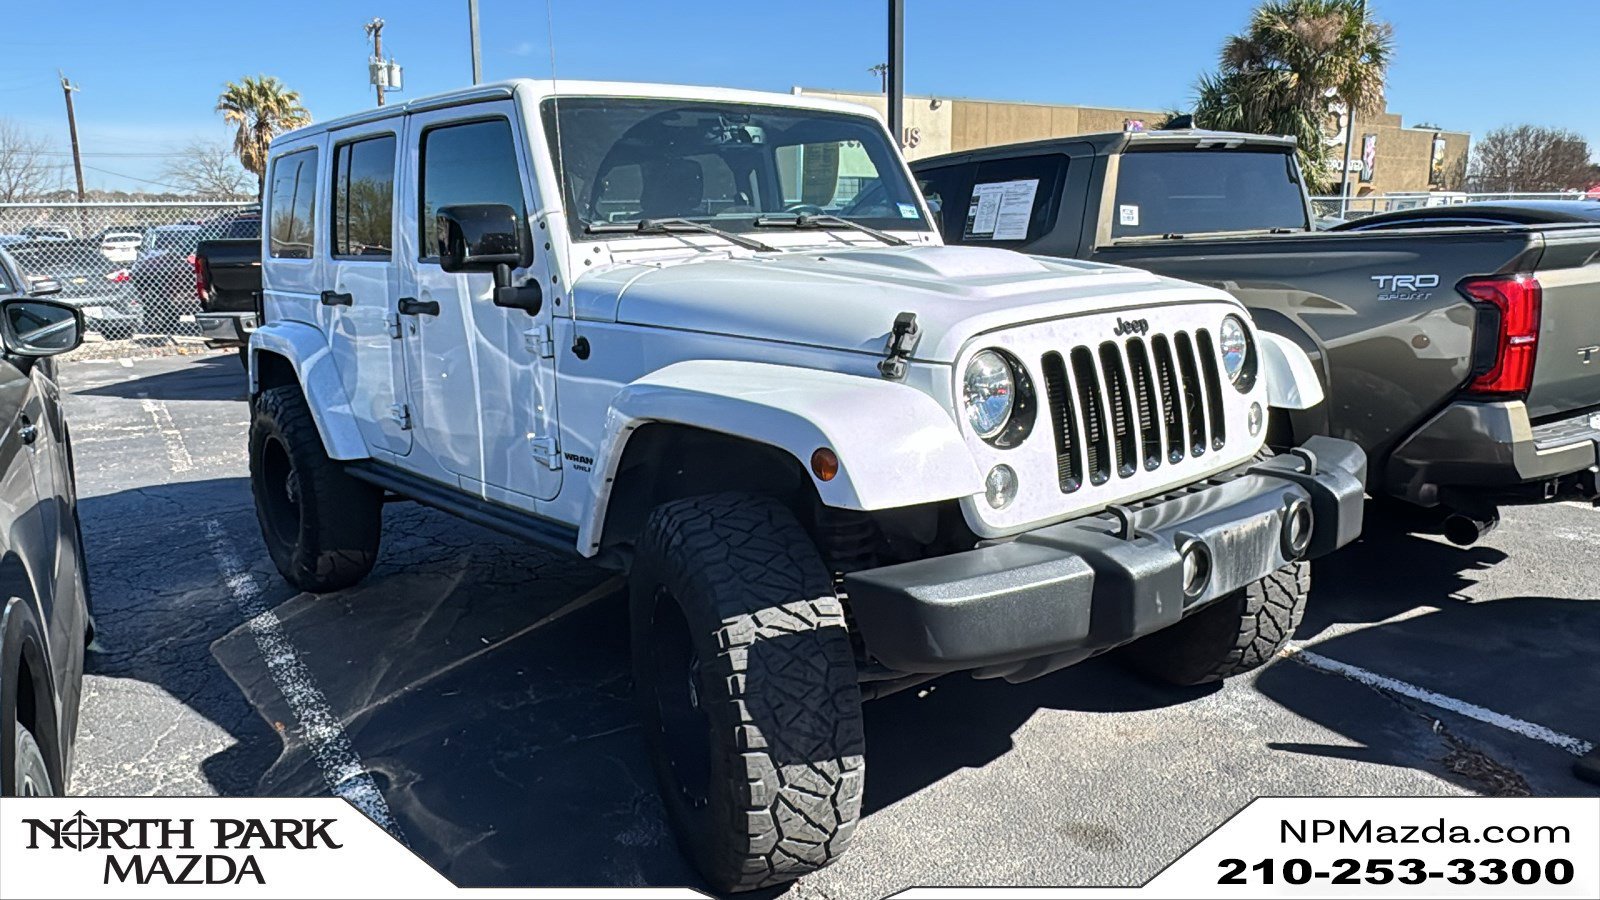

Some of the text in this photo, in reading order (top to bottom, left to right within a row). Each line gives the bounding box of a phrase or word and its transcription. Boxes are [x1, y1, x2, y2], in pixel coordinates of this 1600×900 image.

[1371, 274, 1439, 292] TRD
[1378, 293, 1432, 301] SPORT
[1113, 316, 1149, 336] Jeep
